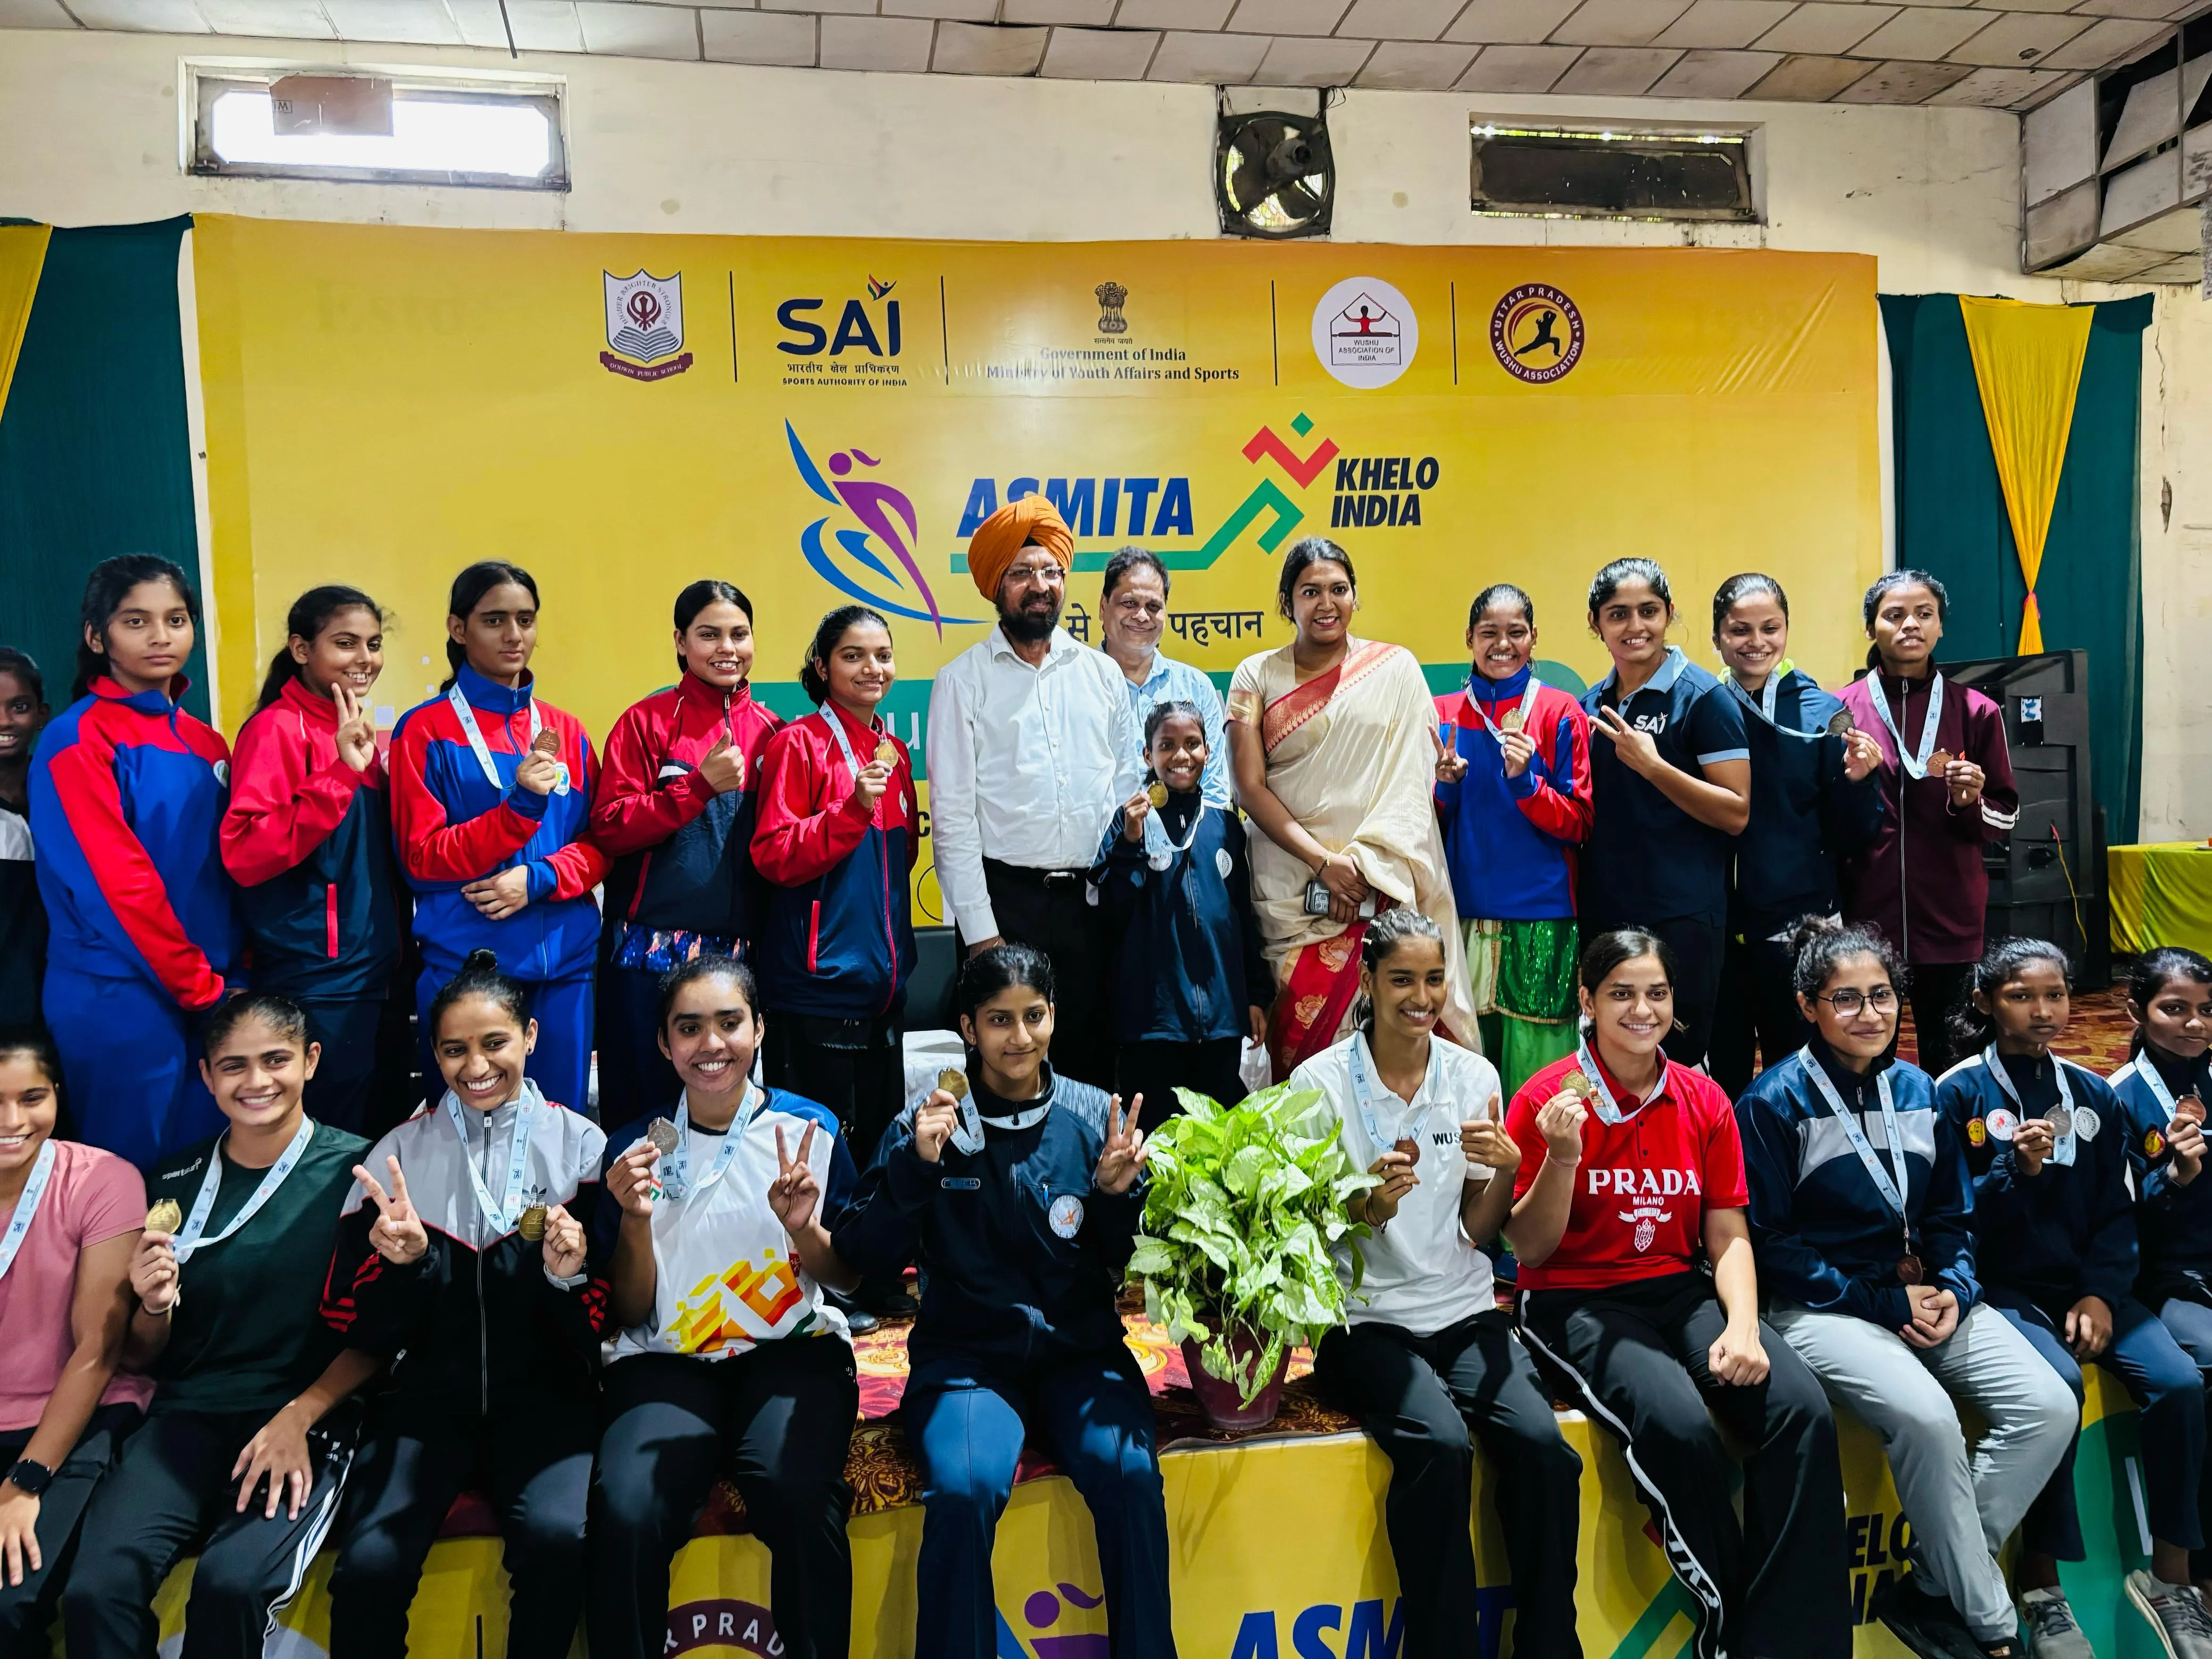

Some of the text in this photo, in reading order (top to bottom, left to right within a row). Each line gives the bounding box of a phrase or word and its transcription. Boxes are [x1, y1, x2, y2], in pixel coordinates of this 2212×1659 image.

[1494, 287, 1580, 329] UTTAR PRADESH
[776, 299, 901, 357] SAI
[1040, 347, 1186, 361] Government of India
[1495, 340, 1580, 380] WUSHU ASSOCIATION
[787, 362, 823, 373] भारतीय
[1069, 366, 1110, 379] Youth
[1113, 366, 1161, 379] Affairs
[1165, 367, 1190, 379] and
[1194, 367, 1239, 382] Sports
[1335, 457, 1439, 491] KHELO
[1330, 494, 1421, 528] INDIA
[1633, 715, 1666, 734] SAI
[1588, 1169, 1701, 1195] PRADA
[1632, 1196, 1664, 1206] MILANO
